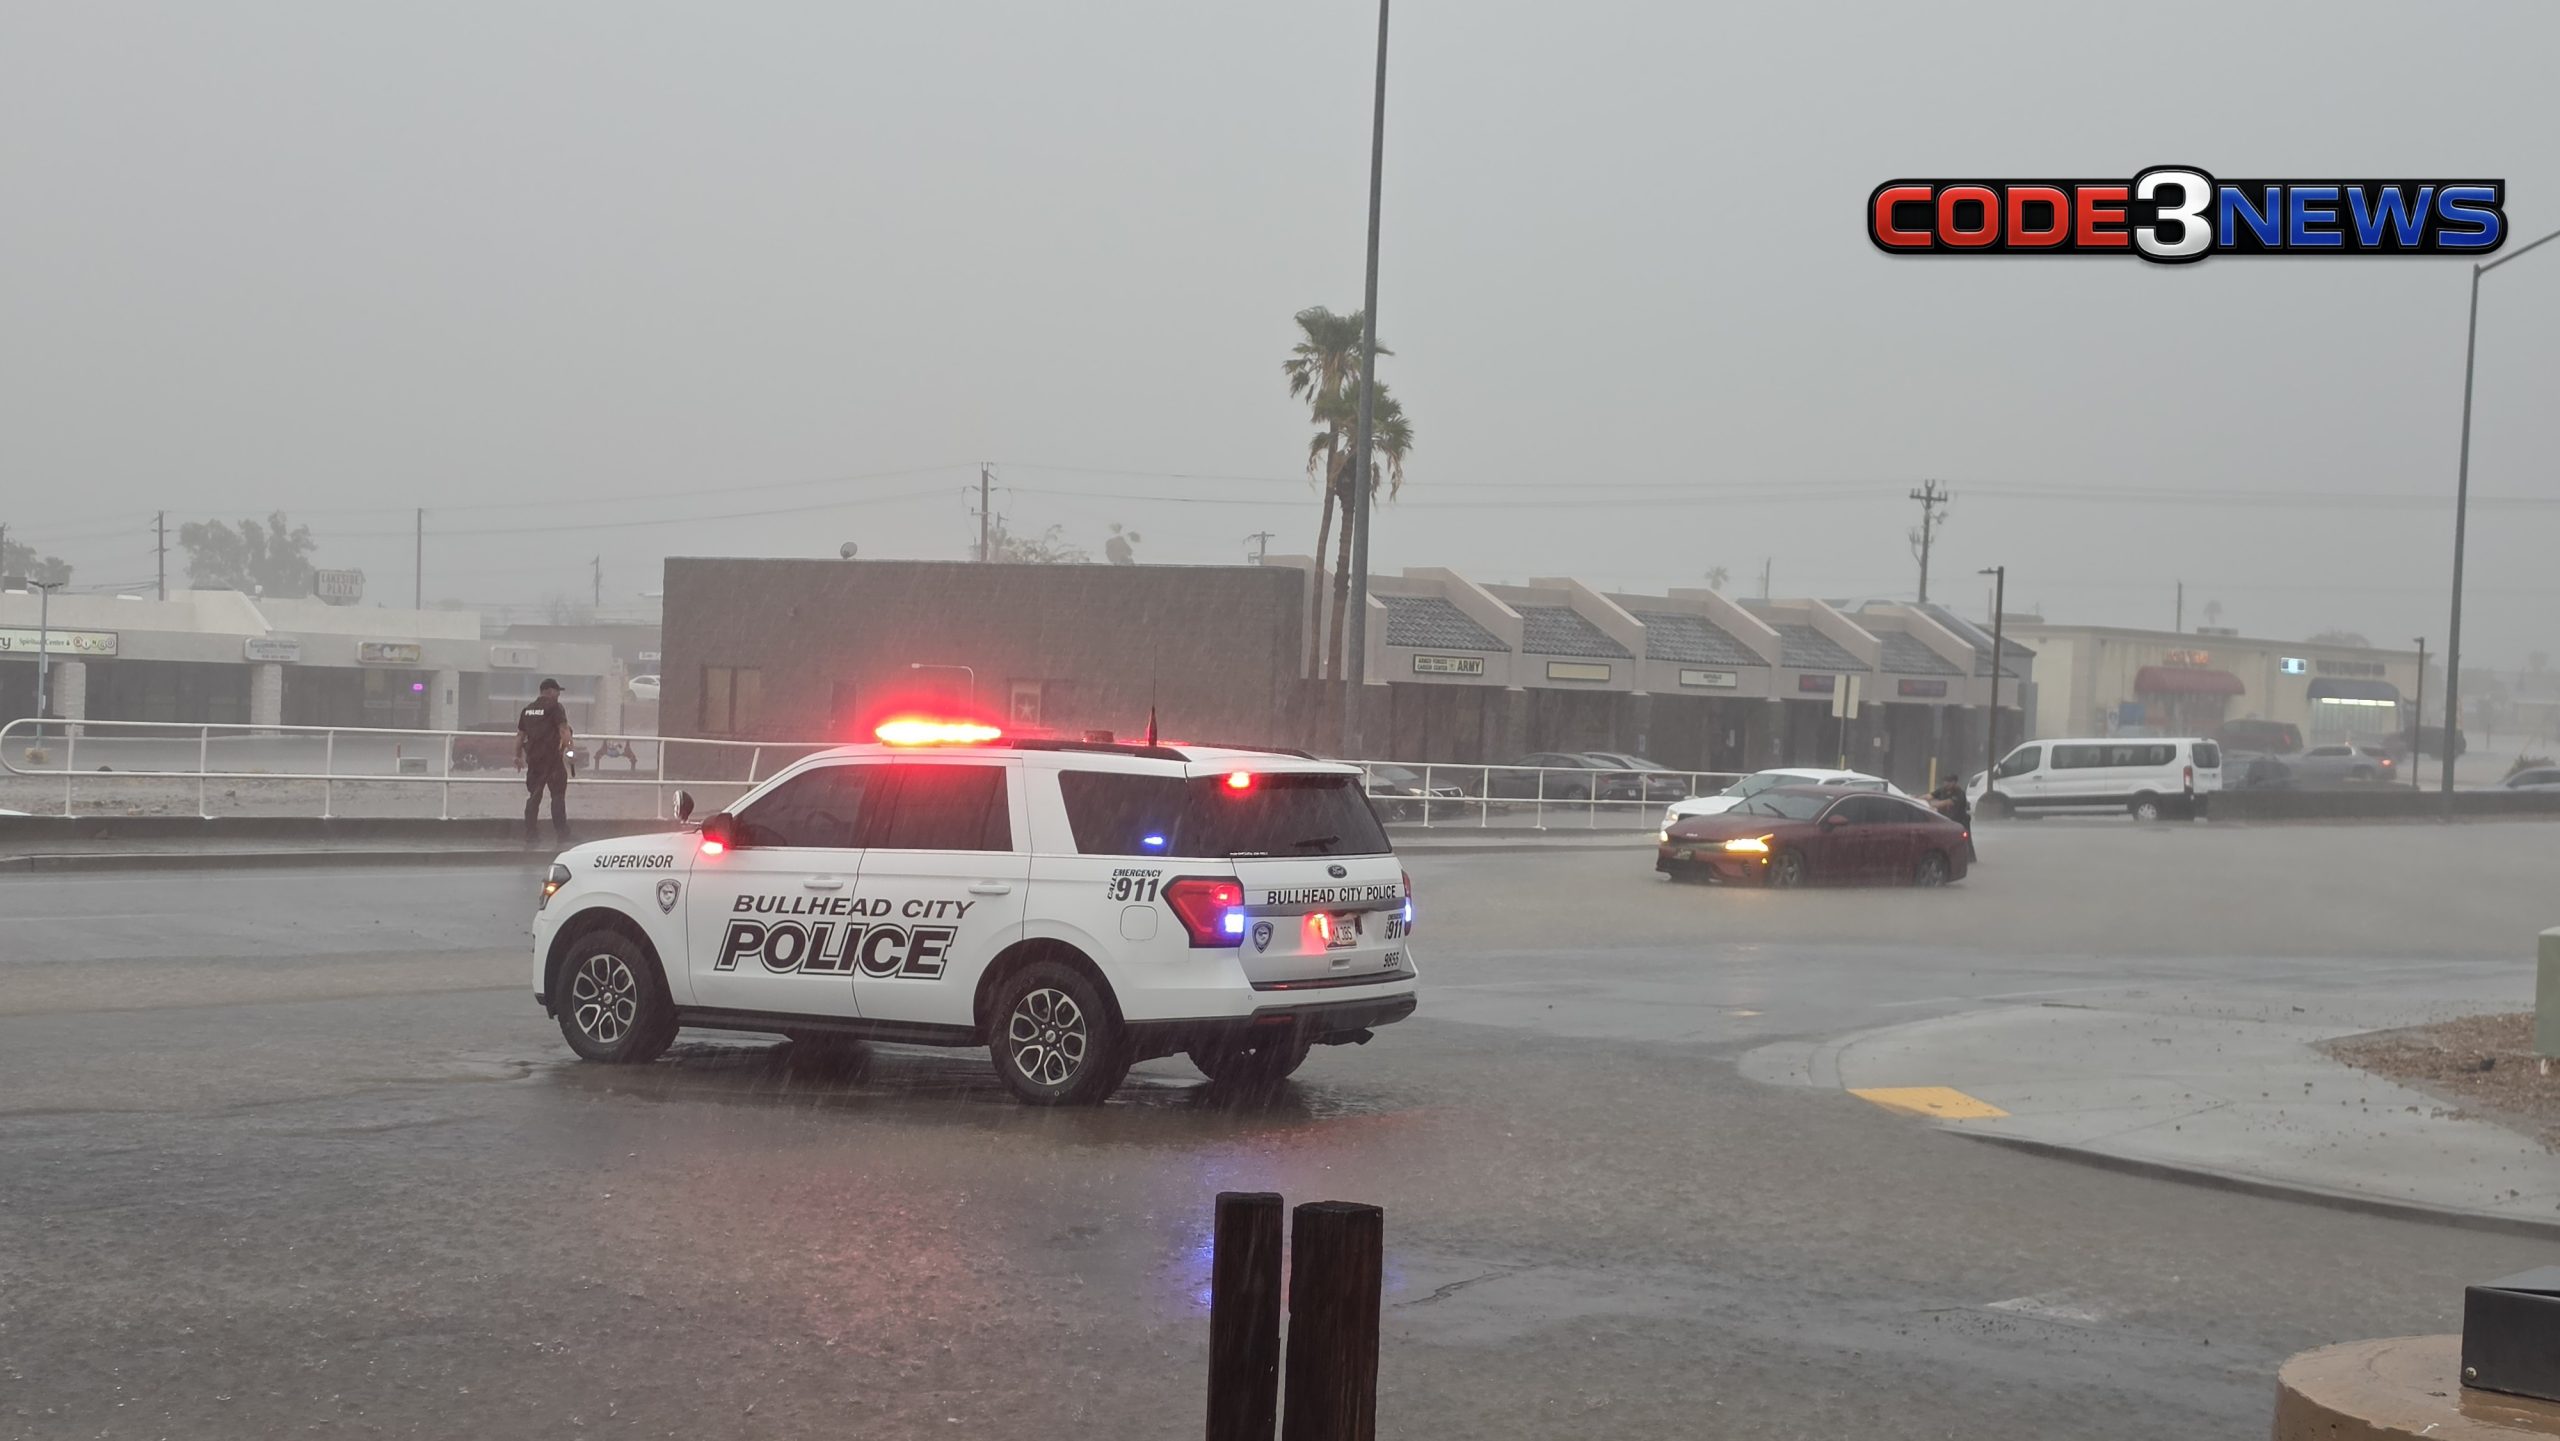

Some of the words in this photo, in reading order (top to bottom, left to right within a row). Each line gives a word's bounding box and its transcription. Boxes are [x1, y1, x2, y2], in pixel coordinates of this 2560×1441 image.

[1457, 660, 1481, 672] ARMY
[593, 854, 674, 868] SUPERVISOR
[1112, 868, 1162, 878] EMERGENCY
[1107, 876, 1118, 900] CALL
[1115, 877, 1160, 902] 911
[1267, 888, 1335, 905] BULLHEAD
[1340, 887, 1363, 902] CITY
[1366, 885, 1397, 900] POLICE
[733, 895, 892, 917] BULLHEAD
[901, 899, 976, 919] CITY
[1388, 920, 1402, 940] 911
[714, 919, 958, 980] POLICE
